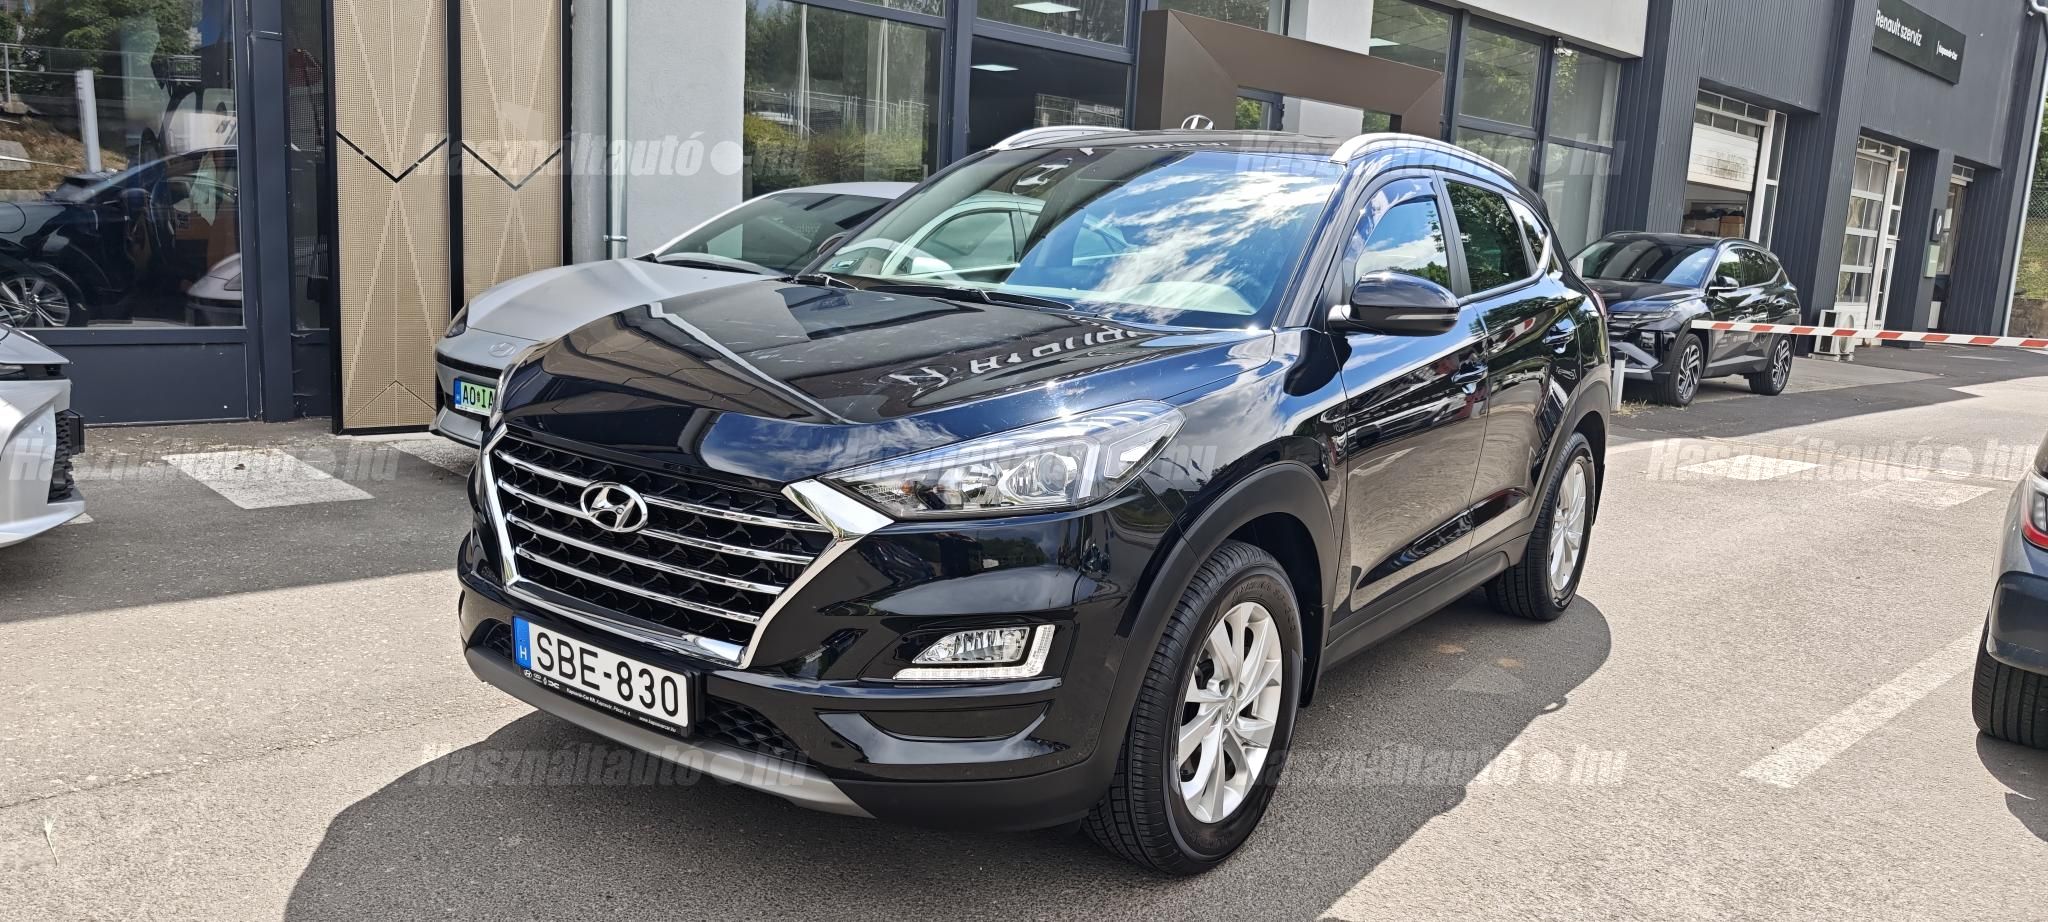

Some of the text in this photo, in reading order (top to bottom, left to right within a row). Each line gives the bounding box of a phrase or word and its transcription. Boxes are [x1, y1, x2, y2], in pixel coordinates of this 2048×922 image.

[1875, 9, 1922, 47] Renault szerviz
[519, 645, 528, 661] H
[536, 632, 679, 718] SBE-830
